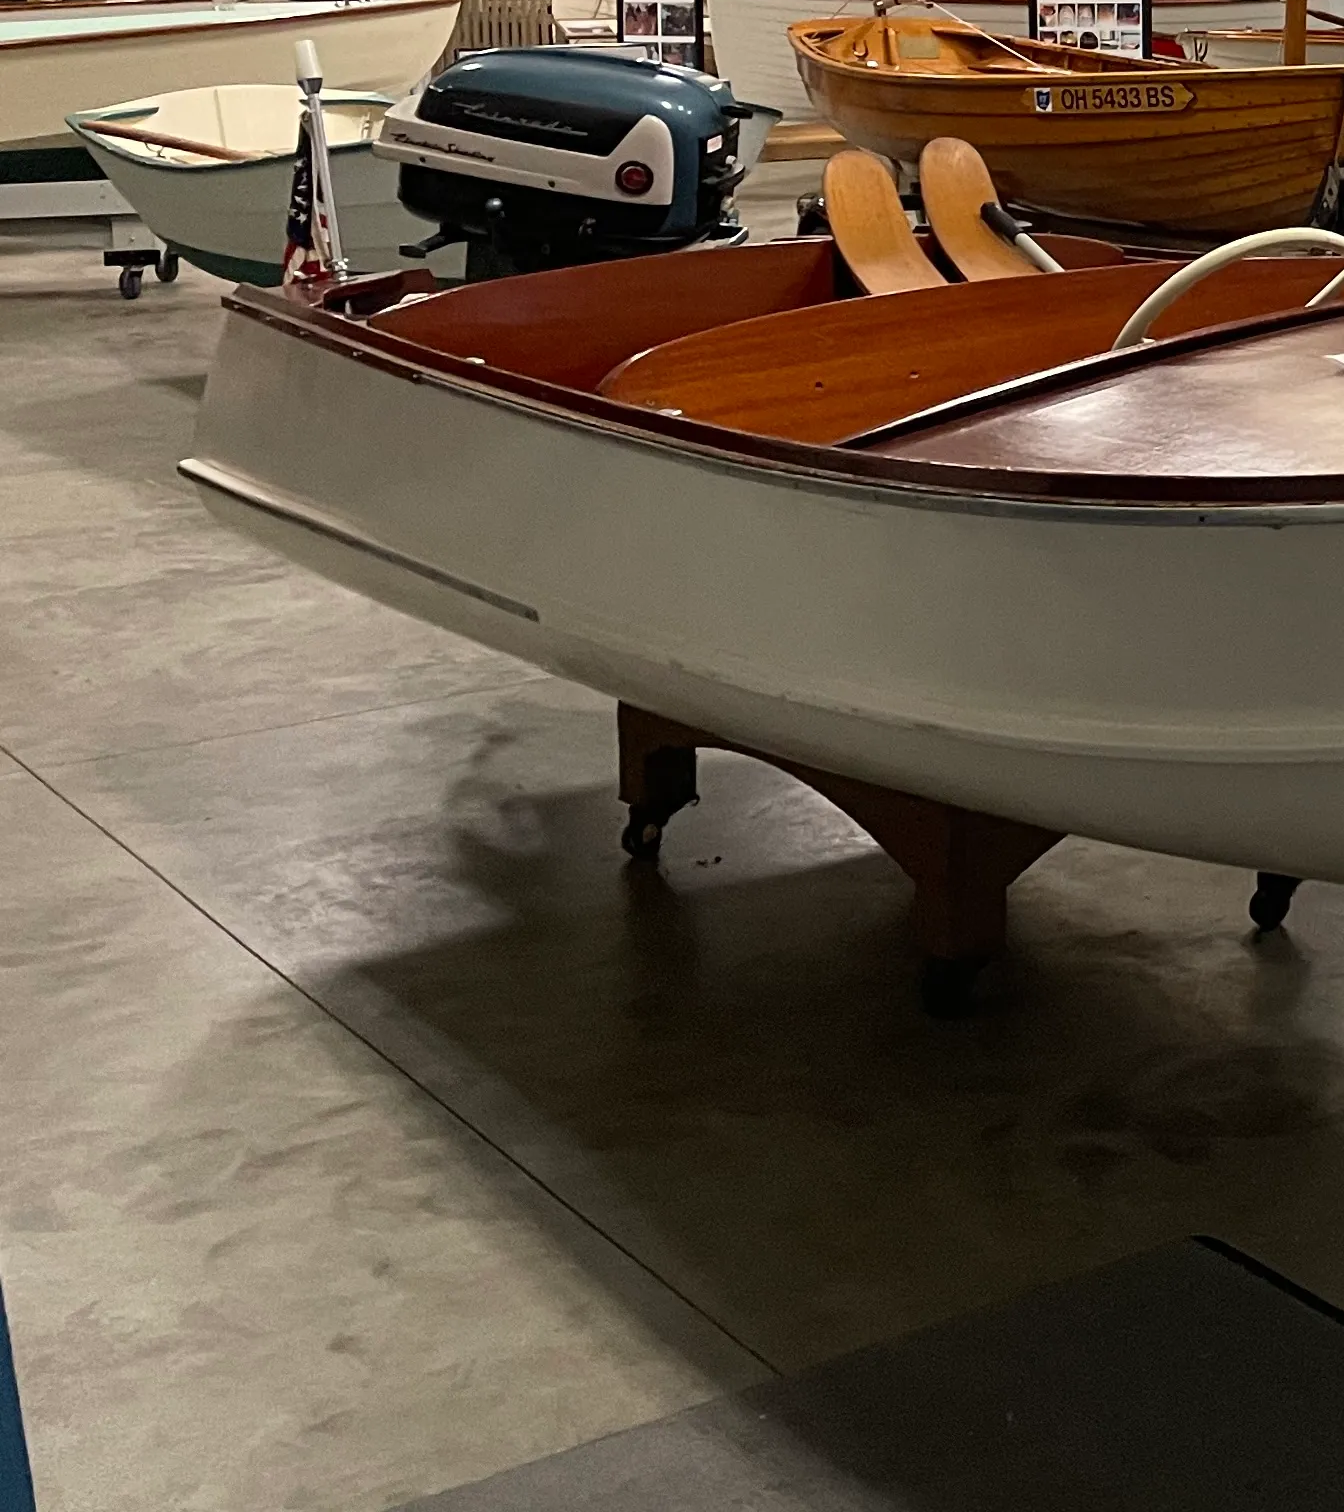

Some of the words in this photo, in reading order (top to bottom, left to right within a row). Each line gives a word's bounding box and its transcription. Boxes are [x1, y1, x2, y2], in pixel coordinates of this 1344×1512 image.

[1061, 89, 1088, 110] OH
[1092, 87, 1141, 109] 5433
[1146, 85, 1175, 108] BS
